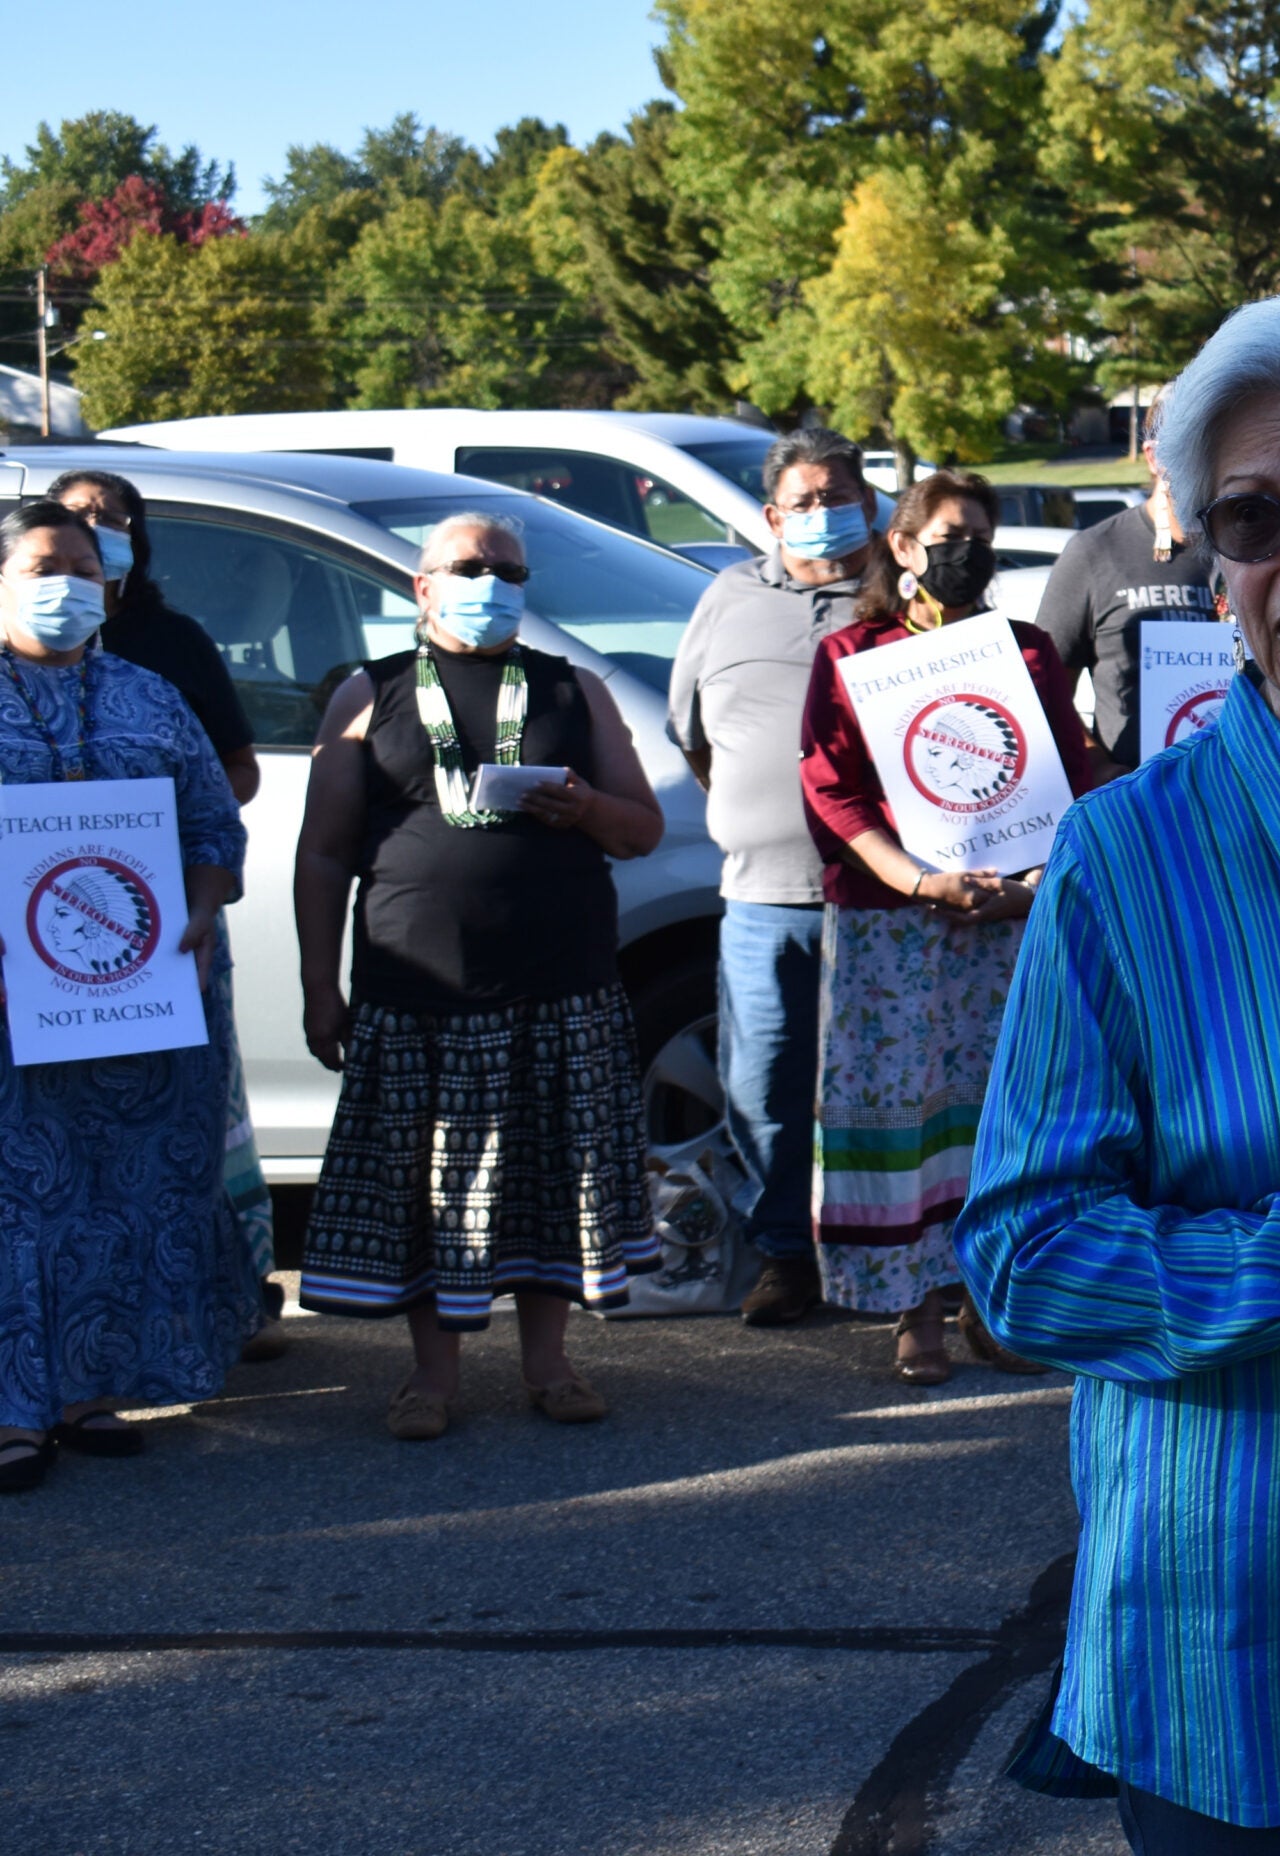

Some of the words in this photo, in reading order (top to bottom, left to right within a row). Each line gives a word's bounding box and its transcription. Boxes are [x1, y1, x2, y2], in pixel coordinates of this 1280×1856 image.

[860, 665, 925, 697] TEACH
[927, 641, 1004, 675] RESPECT
[1153, 650, 1213, 666] TEACH
[894, 692, 934, 738] INDIANS
[935, 682, 958, 697] ARE
[962, 682, 1012, 704] PEOPLE
[938, 695, 956, 706] NO
[1165, 680, 1213, 715] INDIANS
[918, 727, 1019, 768] STEREOTYPES
[939, 812, 971, 826] NOT
[974, 785, 1031, 825] MASCOTS
[940, 799, 954, 811] IN
[954, 803, 979, 813] OUR
[3, 815, 72, 834] TEACH
[79, 811, 165, 831] RESPECT
[936, 837, 978, 862] NOT
[983, 812, 1055, 848] RACISM
[23, 846, 75, 888] INDIANS
[78, 844, 105, 855] ARE
[109, 847, 158, 883] PEOPLE
[79, 856, 98, 867] NO
[49, 882, 148, 950] STEREOTYPES
[50, 975, 82, 997] NOT
[87, 968, 154, 998] MASCOTS
[54, 963, 69, 978] IN
[69, 971, 95, 984] OUR
[96, 957, 146, 984] SCHOOLS
[37, 1008, 87, 1028] NOT
[93, 1001, 175, 1023] RACISM
